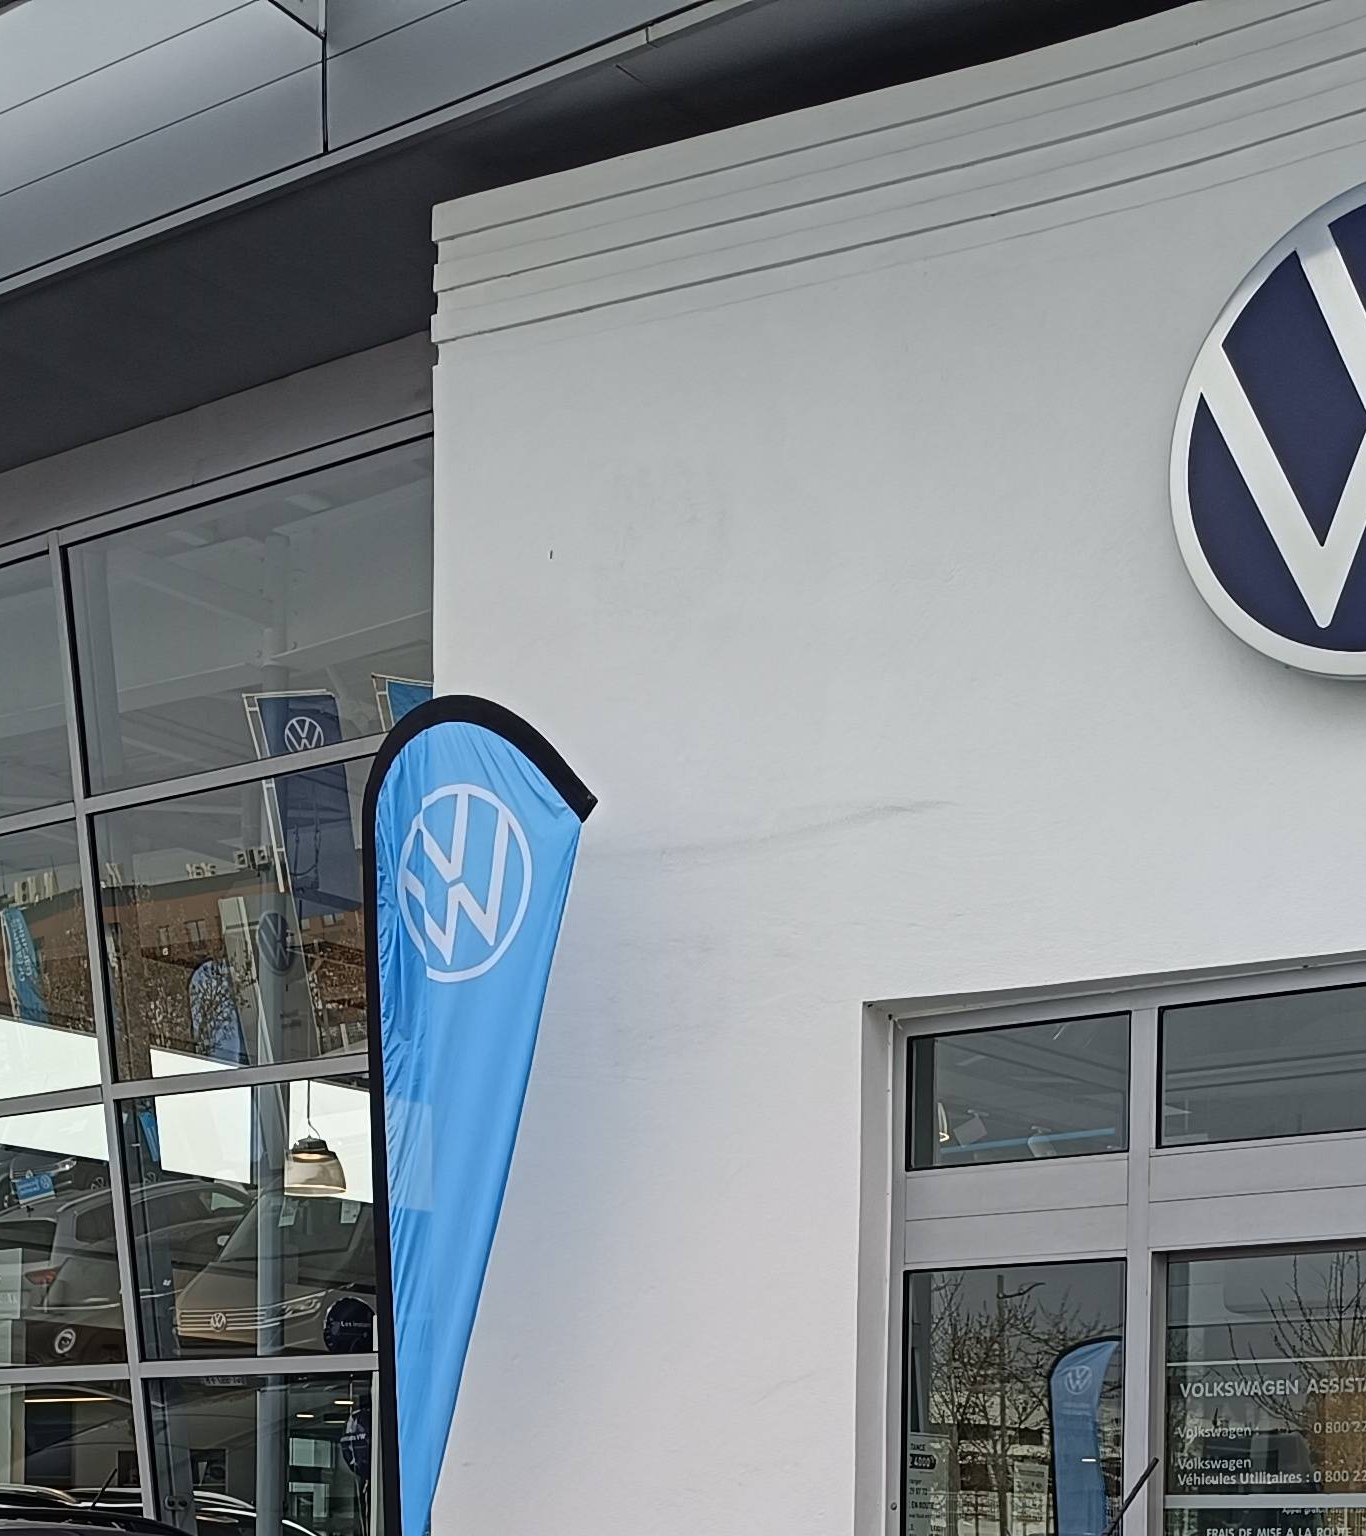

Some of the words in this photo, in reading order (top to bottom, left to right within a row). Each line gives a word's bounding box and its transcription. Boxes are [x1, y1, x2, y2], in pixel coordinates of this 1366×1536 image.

[1180, 1379, 1299, 1398] VOLKSWAGEN
[1178, 1425, 1252, 1439] Volkswagen
[1325, 1421, 1350, 1433] 800
[1178, 1457, 1252, 1472] Volkswagen
[1178, 1473, 1236, 1487] Véhicules
[1240, 1471, 1302, 1485] Utilitaires
[1325, 1470, 1350, 1482] 800
